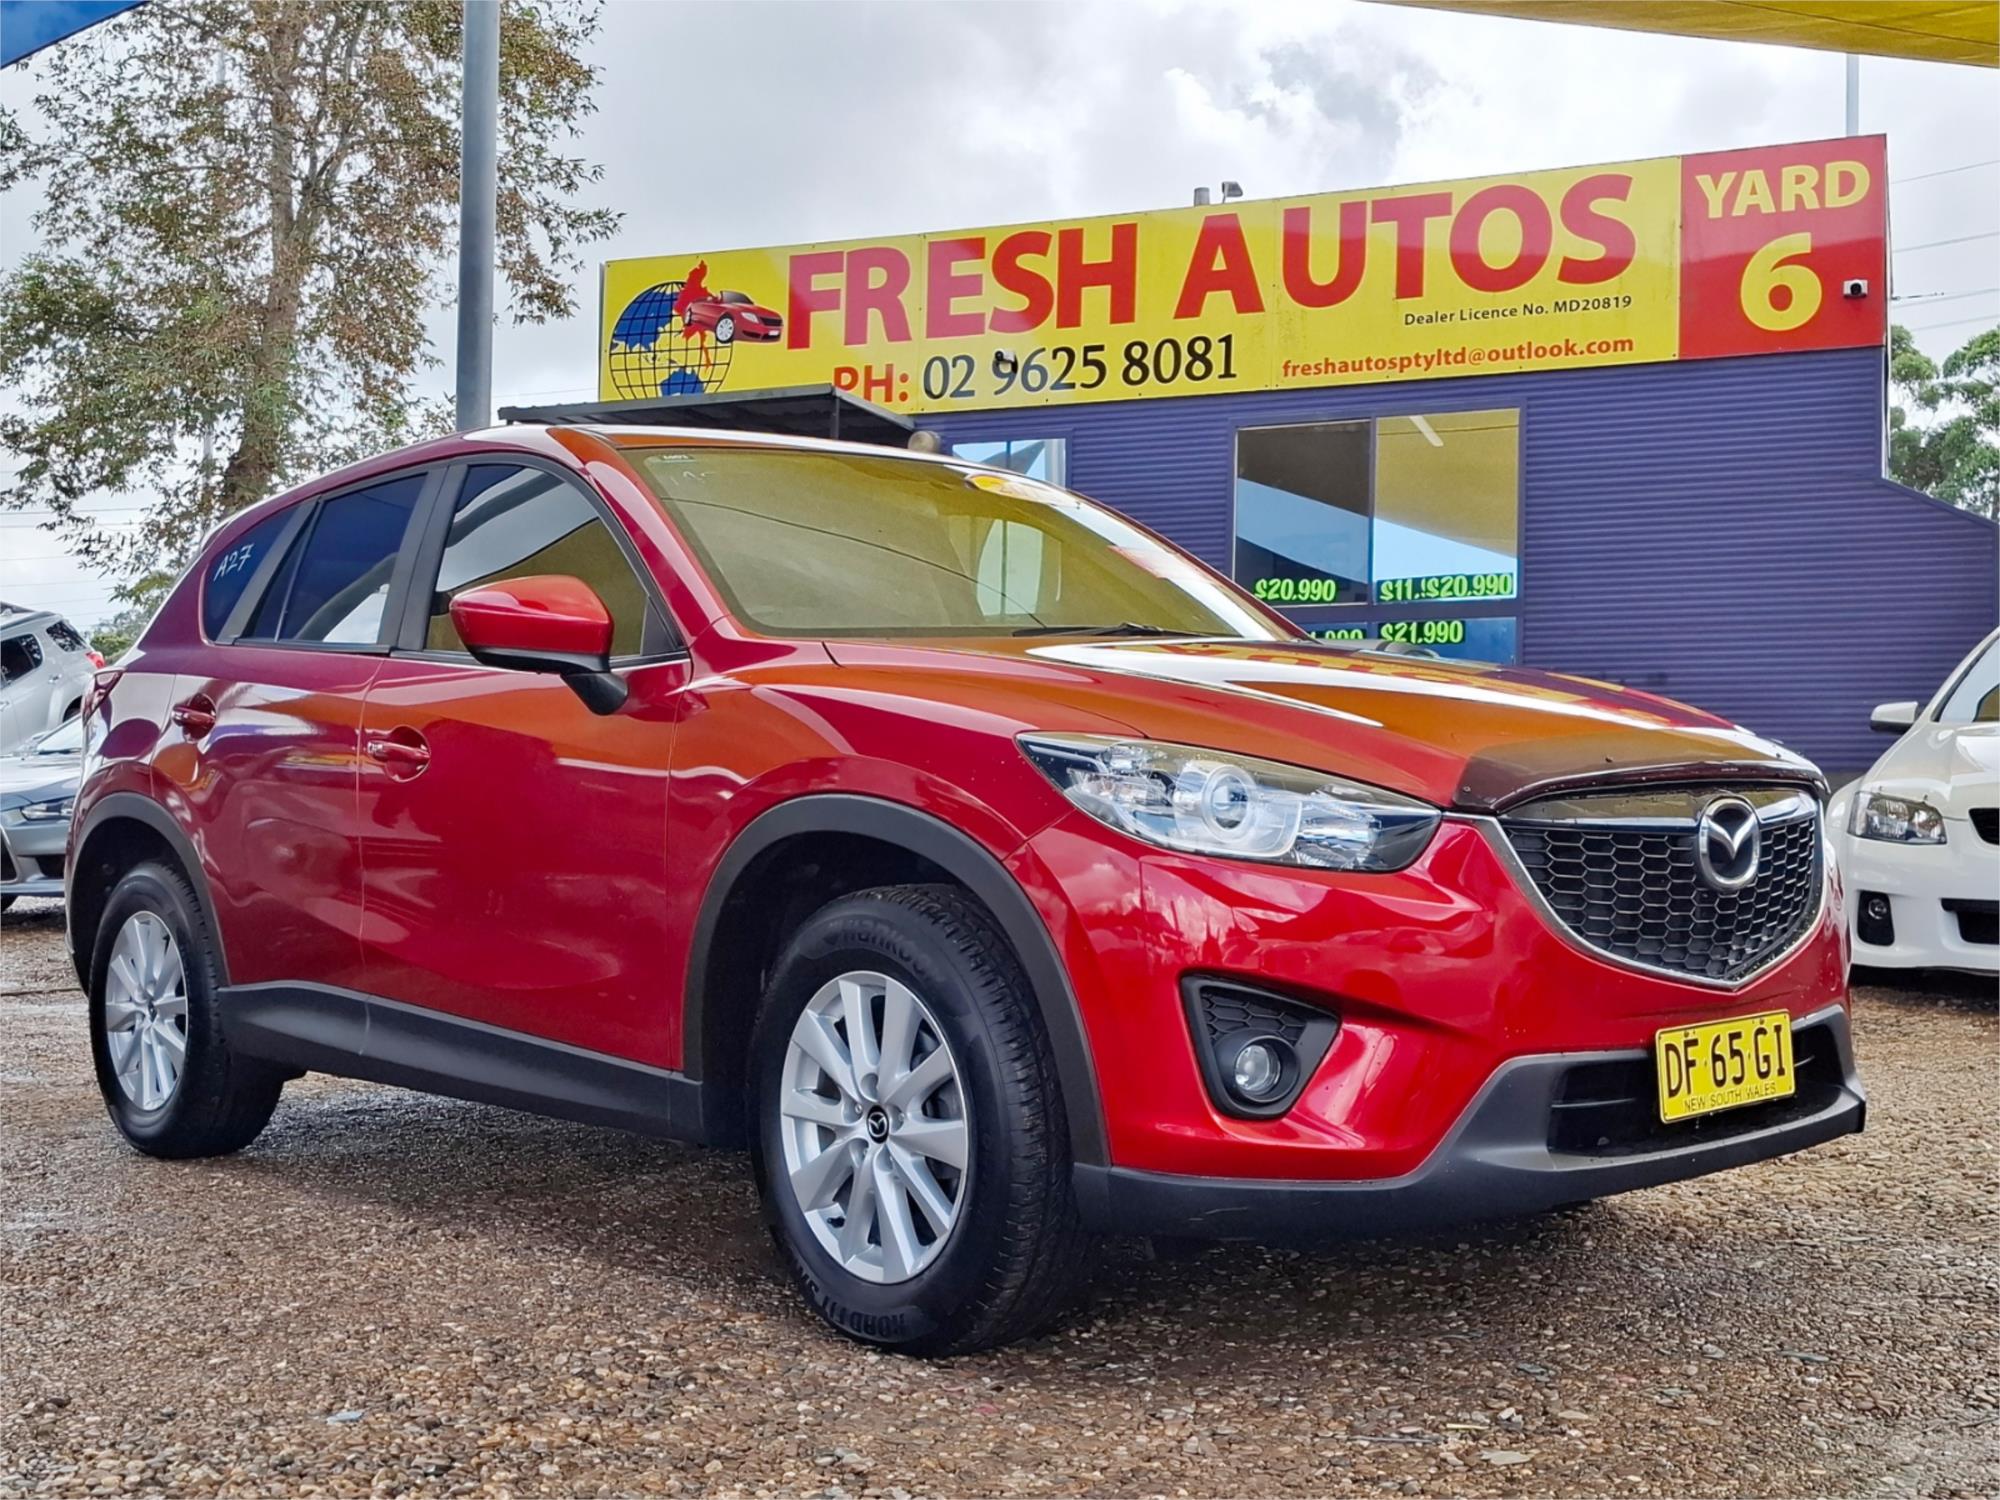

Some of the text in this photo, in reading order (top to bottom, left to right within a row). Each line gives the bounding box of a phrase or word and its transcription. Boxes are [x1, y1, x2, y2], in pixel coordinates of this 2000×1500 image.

[1697, 161, 1872, 220] YARD
[786, 173, 1637, 348] FRESH AUTOS
[1740, 231, 1823, 332] 6
[1404, 295, 1632, 326] Dealer Licence No. MD20819
[833, 334, 1237, 403] PH: 02 9625 8081
[1282, 338, 1634, 379] freshautosptyltd@outlook.com
[213, 543, 255, 582] A27
[1664, 1038, 1699, 1098] DF
[1711, 1031, 1746, 1088] 65
[1684, 1082, 1777, 1112] NEW SOUTH WALES
